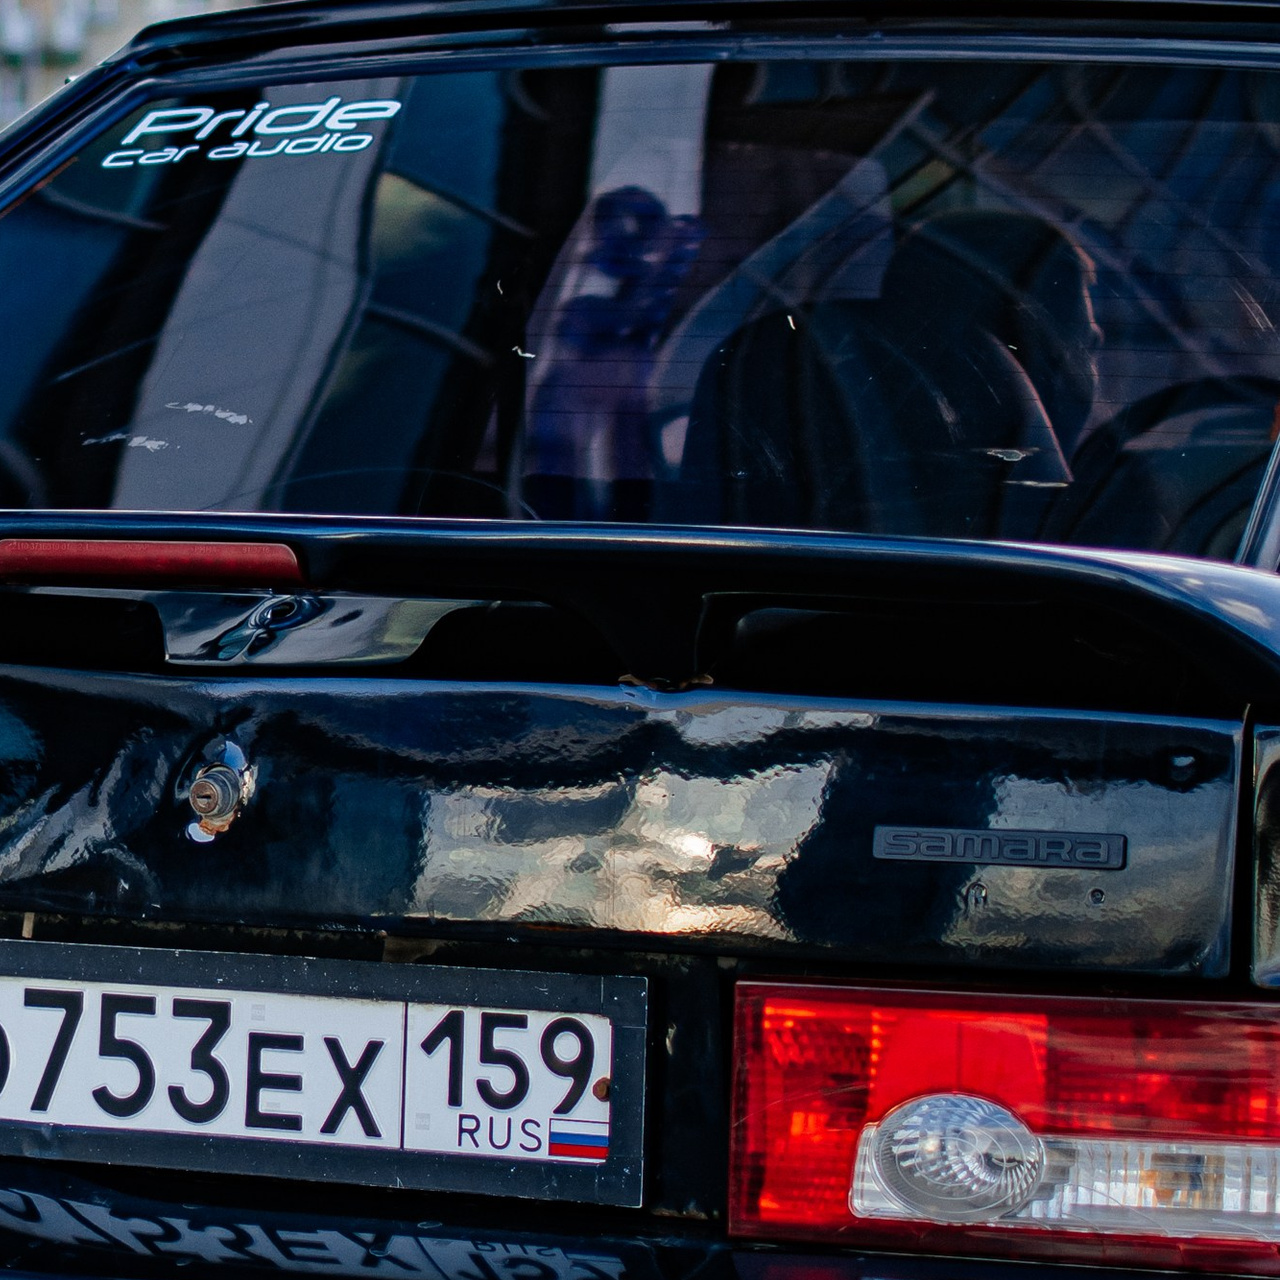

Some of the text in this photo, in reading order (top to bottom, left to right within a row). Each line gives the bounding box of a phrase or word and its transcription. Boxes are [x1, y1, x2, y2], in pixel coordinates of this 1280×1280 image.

[121, 95, 402, 145] Pride
[101, 132, 373, 168] car audio
[419, 1009, 596, 1115] 159
[456, 1113, 543, 1152] RUS
